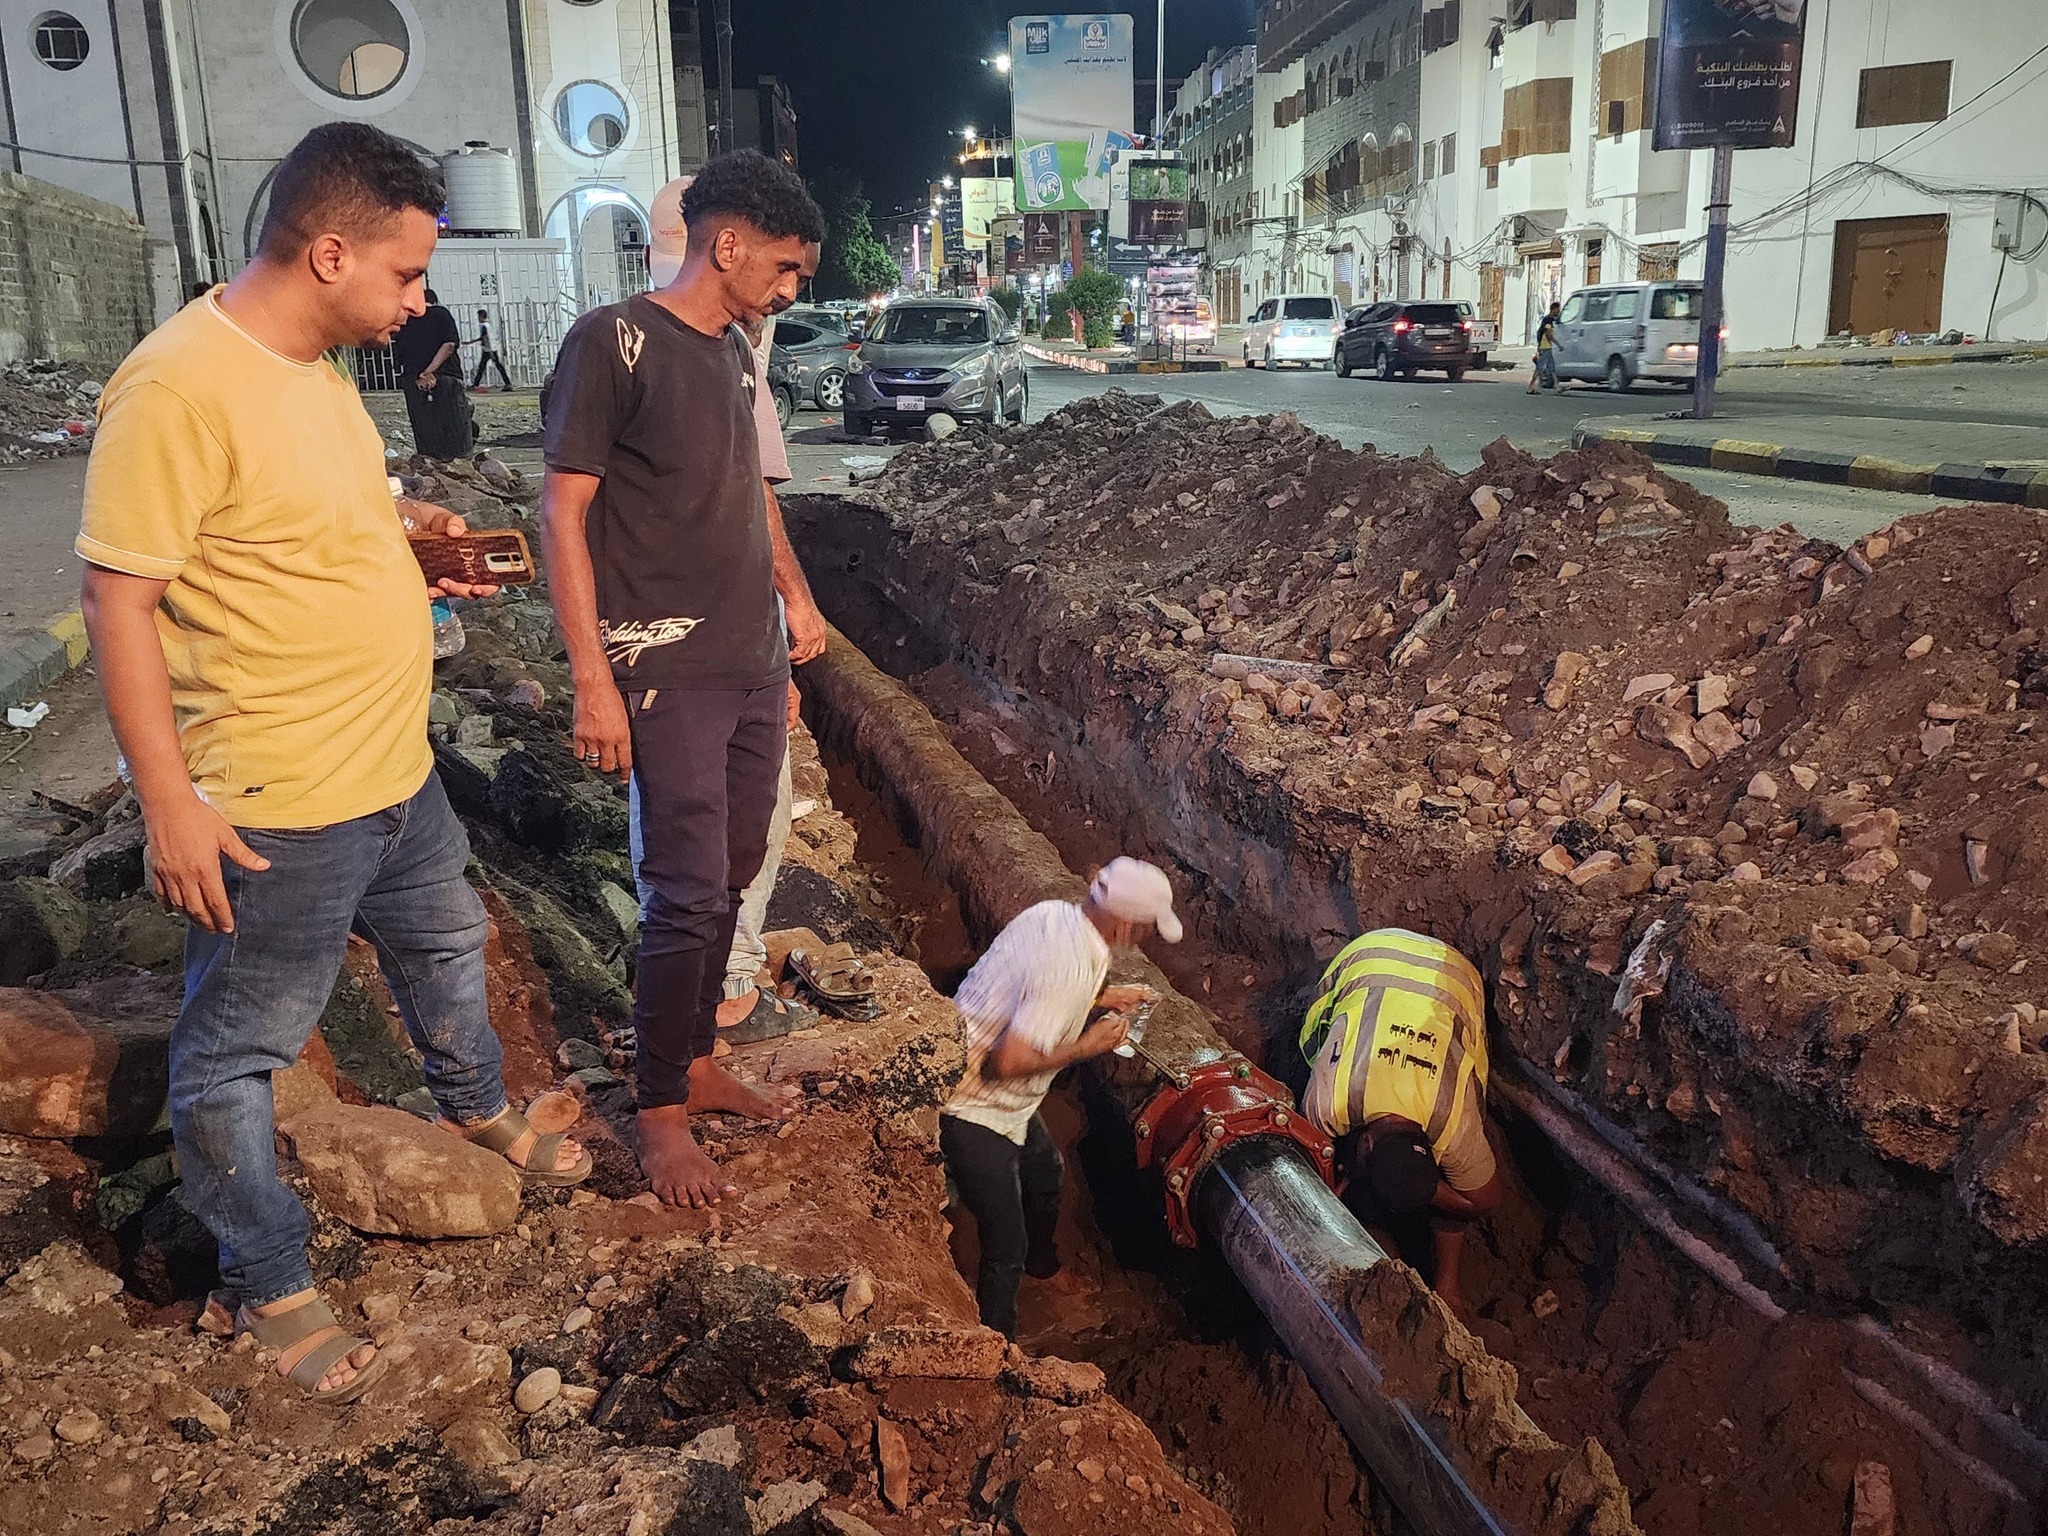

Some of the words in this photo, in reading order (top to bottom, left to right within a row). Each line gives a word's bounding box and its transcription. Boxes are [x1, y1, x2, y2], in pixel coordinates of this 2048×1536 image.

[1027, 26, 1048, 38] Milk
[1696, 61, 1731, 75] البنكية
[1769, 61, 1792, 73] اطلب
[1736, 77, 1760, 90] فروع
[1762, 75, 1778, 86] أحد
[1778, 78, 1791, 89] من
[458, 545, 478, 578] Dior
